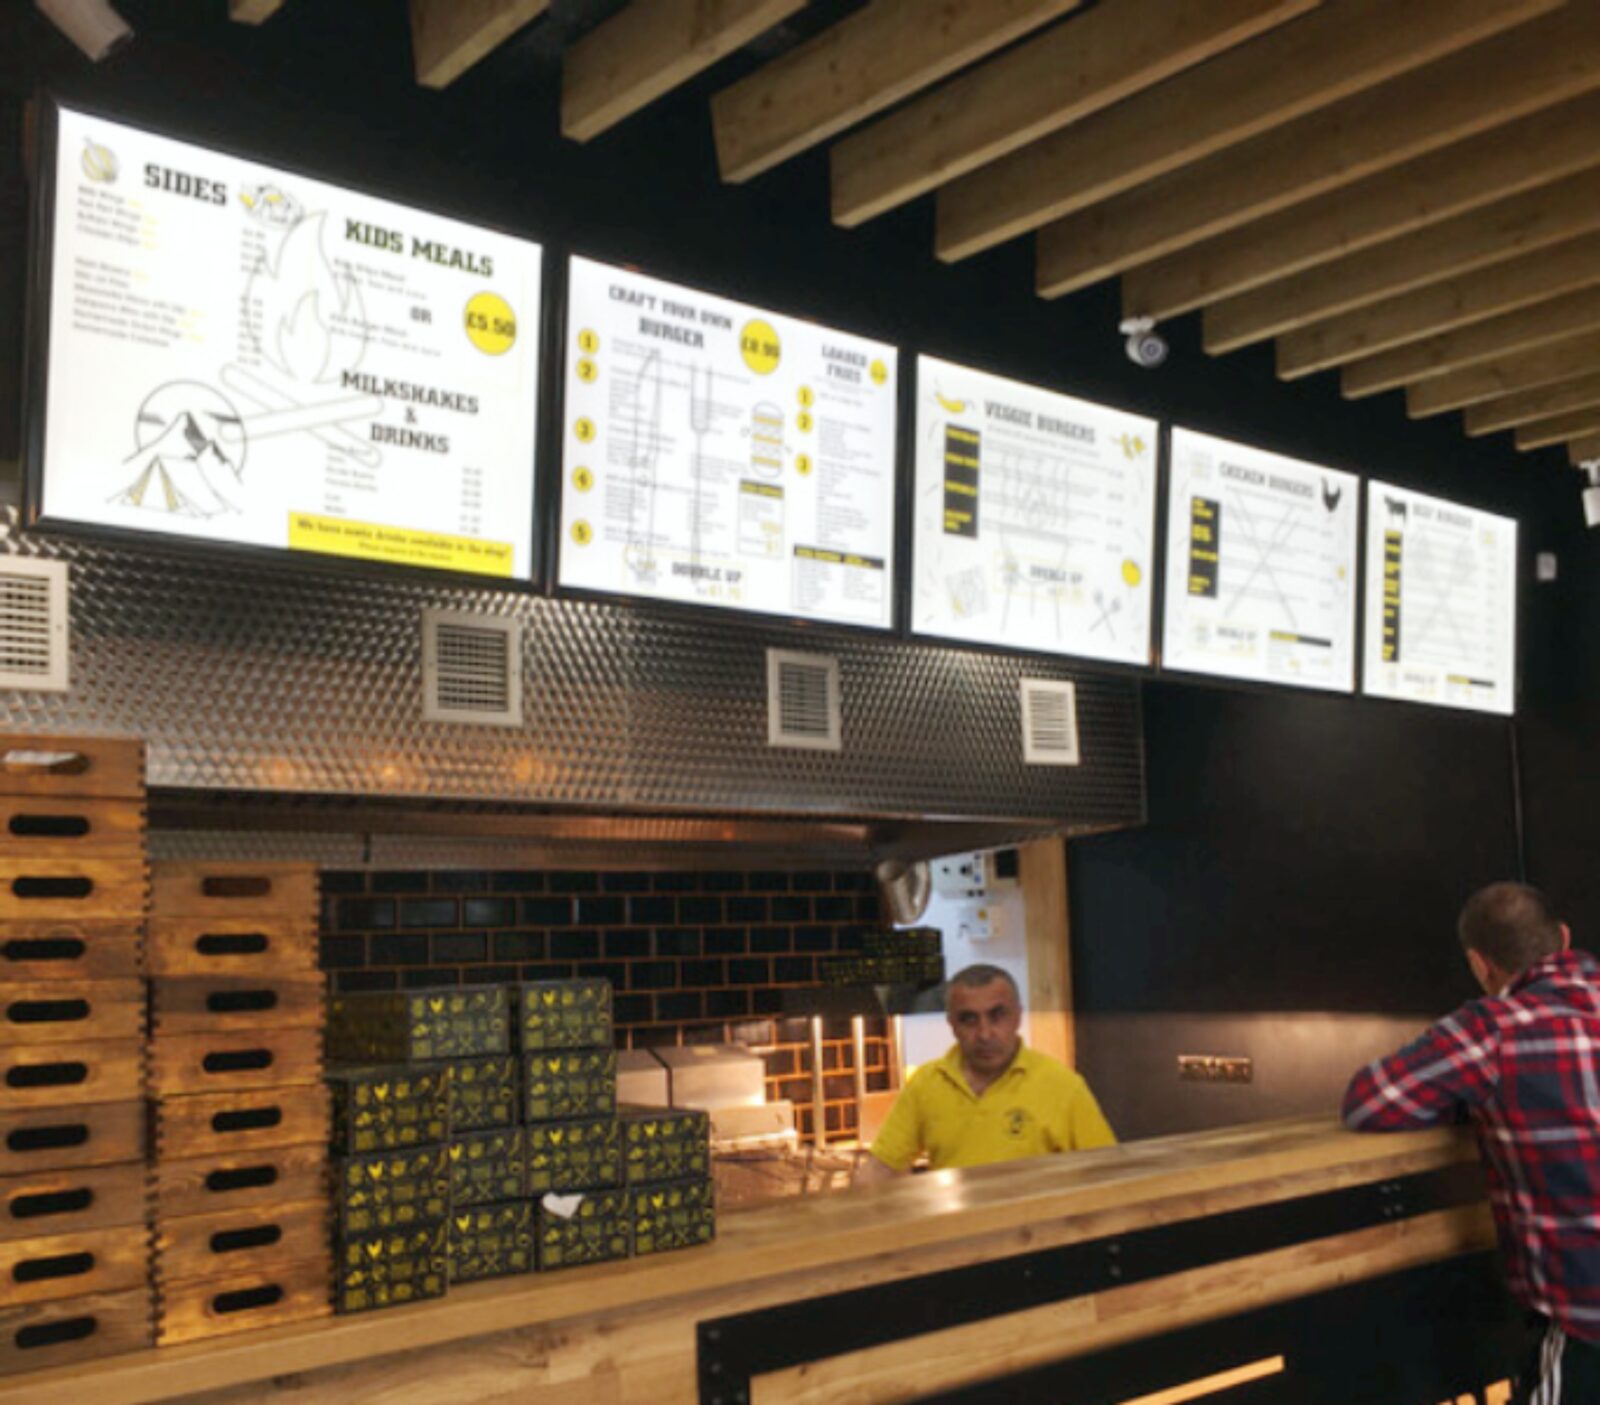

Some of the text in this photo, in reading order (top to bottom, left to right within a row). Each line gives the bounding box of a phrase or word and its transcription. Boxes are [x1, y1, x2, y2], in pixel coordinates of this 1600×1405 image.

[143, 162, 228, 206] SIDES
[345, 217, 404, 254] KIDS
[411, 235, 494, 278] MEALS
[409, 306, 433, 325] OR
[608, 284, 733, 331] CRAFT YOUR OWN
[465, 311, 517, 338] £5.50
[639, 316, 704, 348] BURGER
[340, 369, 480, 414] MILKSHAKES
[404, 406, 417, 424] &
[370, 421, 451, 454] DRINKS
